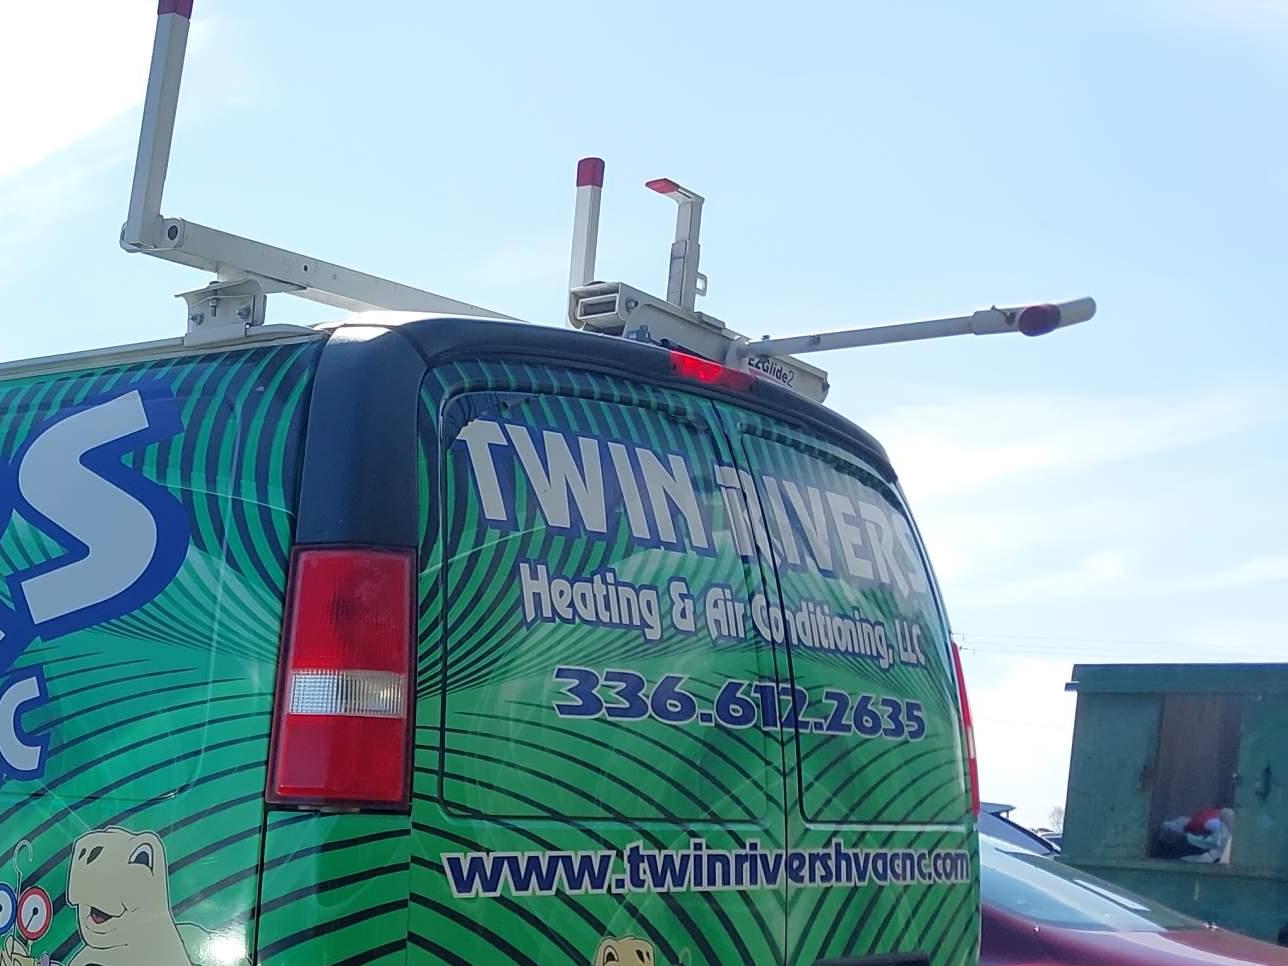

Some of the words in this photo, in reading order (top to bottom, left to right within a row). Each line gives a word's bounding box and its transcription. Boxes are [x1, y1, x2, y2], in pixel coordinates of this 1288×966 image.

[456, 418, 712, 552] TWIN
[714, 464, 928, 599] RIVERS
[520, 560, 661, 640] Heating
[671, 578, 696, 634] &
[705, 585, 746, 641] Air
[751, 592, 895, 669] Conditioning,
[895, 617, 926, 666] LLC
[553, 666, 927, 741] 336.612.2635
[442, 840, 970, 898] www.twinrivershvacnc.com
